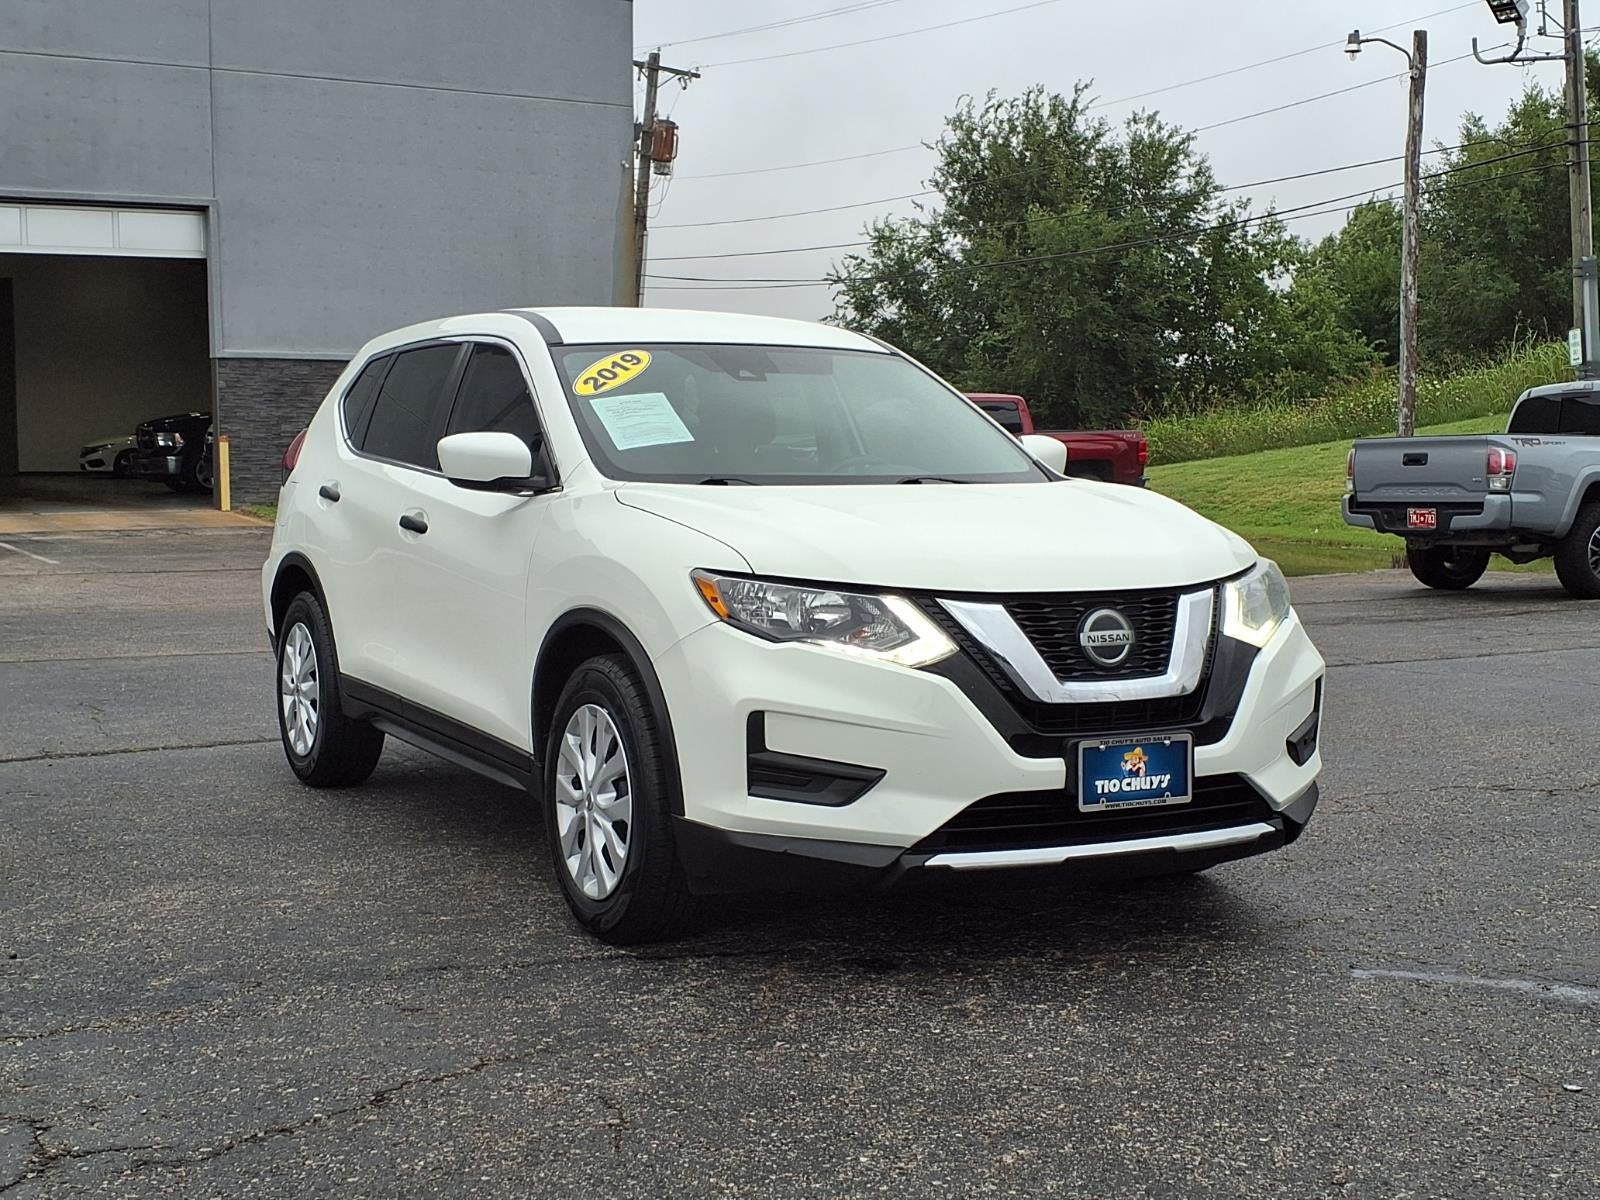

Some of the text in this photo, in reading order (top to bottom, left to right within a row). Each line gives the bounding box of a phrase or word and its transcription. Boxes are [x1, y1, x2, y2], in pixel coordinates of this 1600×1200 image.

[583, 353, 642, 391] 2019
[1510, 437, 1542, 447] TRD
[1381, 488, 1458, 496] TACOMA
[1087, 633, 1130, 643] NISSAN
[1094, 773, 1171, 794] TIO CHUY'S
